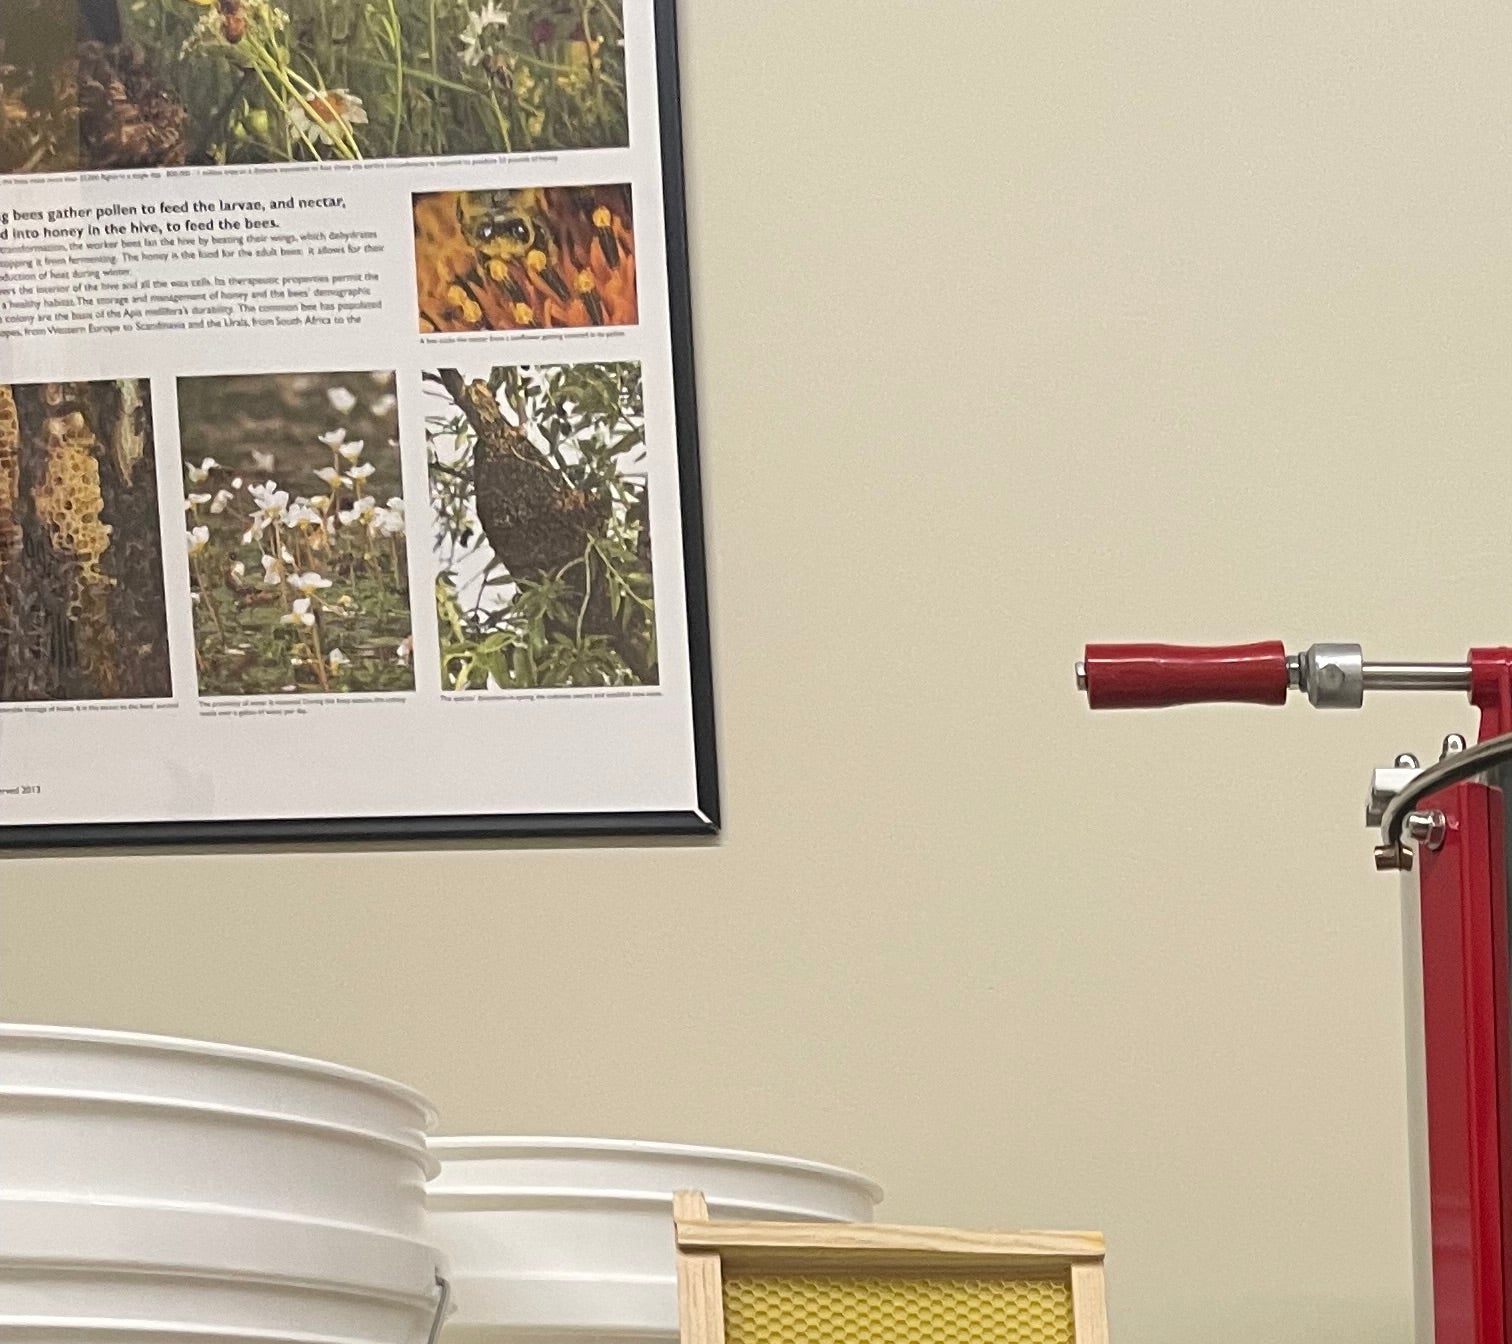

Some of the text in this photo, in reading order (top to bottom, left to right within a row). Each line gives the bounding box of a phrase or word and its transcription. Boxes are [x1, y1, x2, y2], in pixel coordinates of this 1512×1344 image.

[13, 209, 43, 221] bees
[48, 206, 91, 222] gather
[96, 204, 137, 220] pollen
[142, 204, 155, 214] to
[160, 201, 188, 213] feed
[193, 200, 215, 212] the
[219, 200, 265, 211] larvae,
[270, 196, 294, 209] and
[299, 197, 346, 208] nectar,
[13, 228, 39, 239] into
[44, 227, 84, 238] honey
[88, 225, 100, 235] in
[105, 224, 127, 234] the
[131, 221, 162, 234] hive,
[167, 222, 180, 232] to
[185, 219, 213, 231] feed
[219, 218, 240, 229] the
[245, 218, 280, 229] bees.
[161, 238, 174, 246] the
[300, 232, 326, 240] which
[123, 252, 139, 262] The
[142, 253, 168, 263] honey
[181, 250, 195, 259] the
[85, 283, 97, 291] the
[77, 297, 93, 305] The
[221, 291, 248, 301] honey
[270, 290, 284, 298] the
[5, 316, 34, 325] colony
[89, 323, 120, 334] Europe
[207, 319, 221, 327] the
[305, 316, 331, 324] Africa
[347, 315, 361, 323] the
